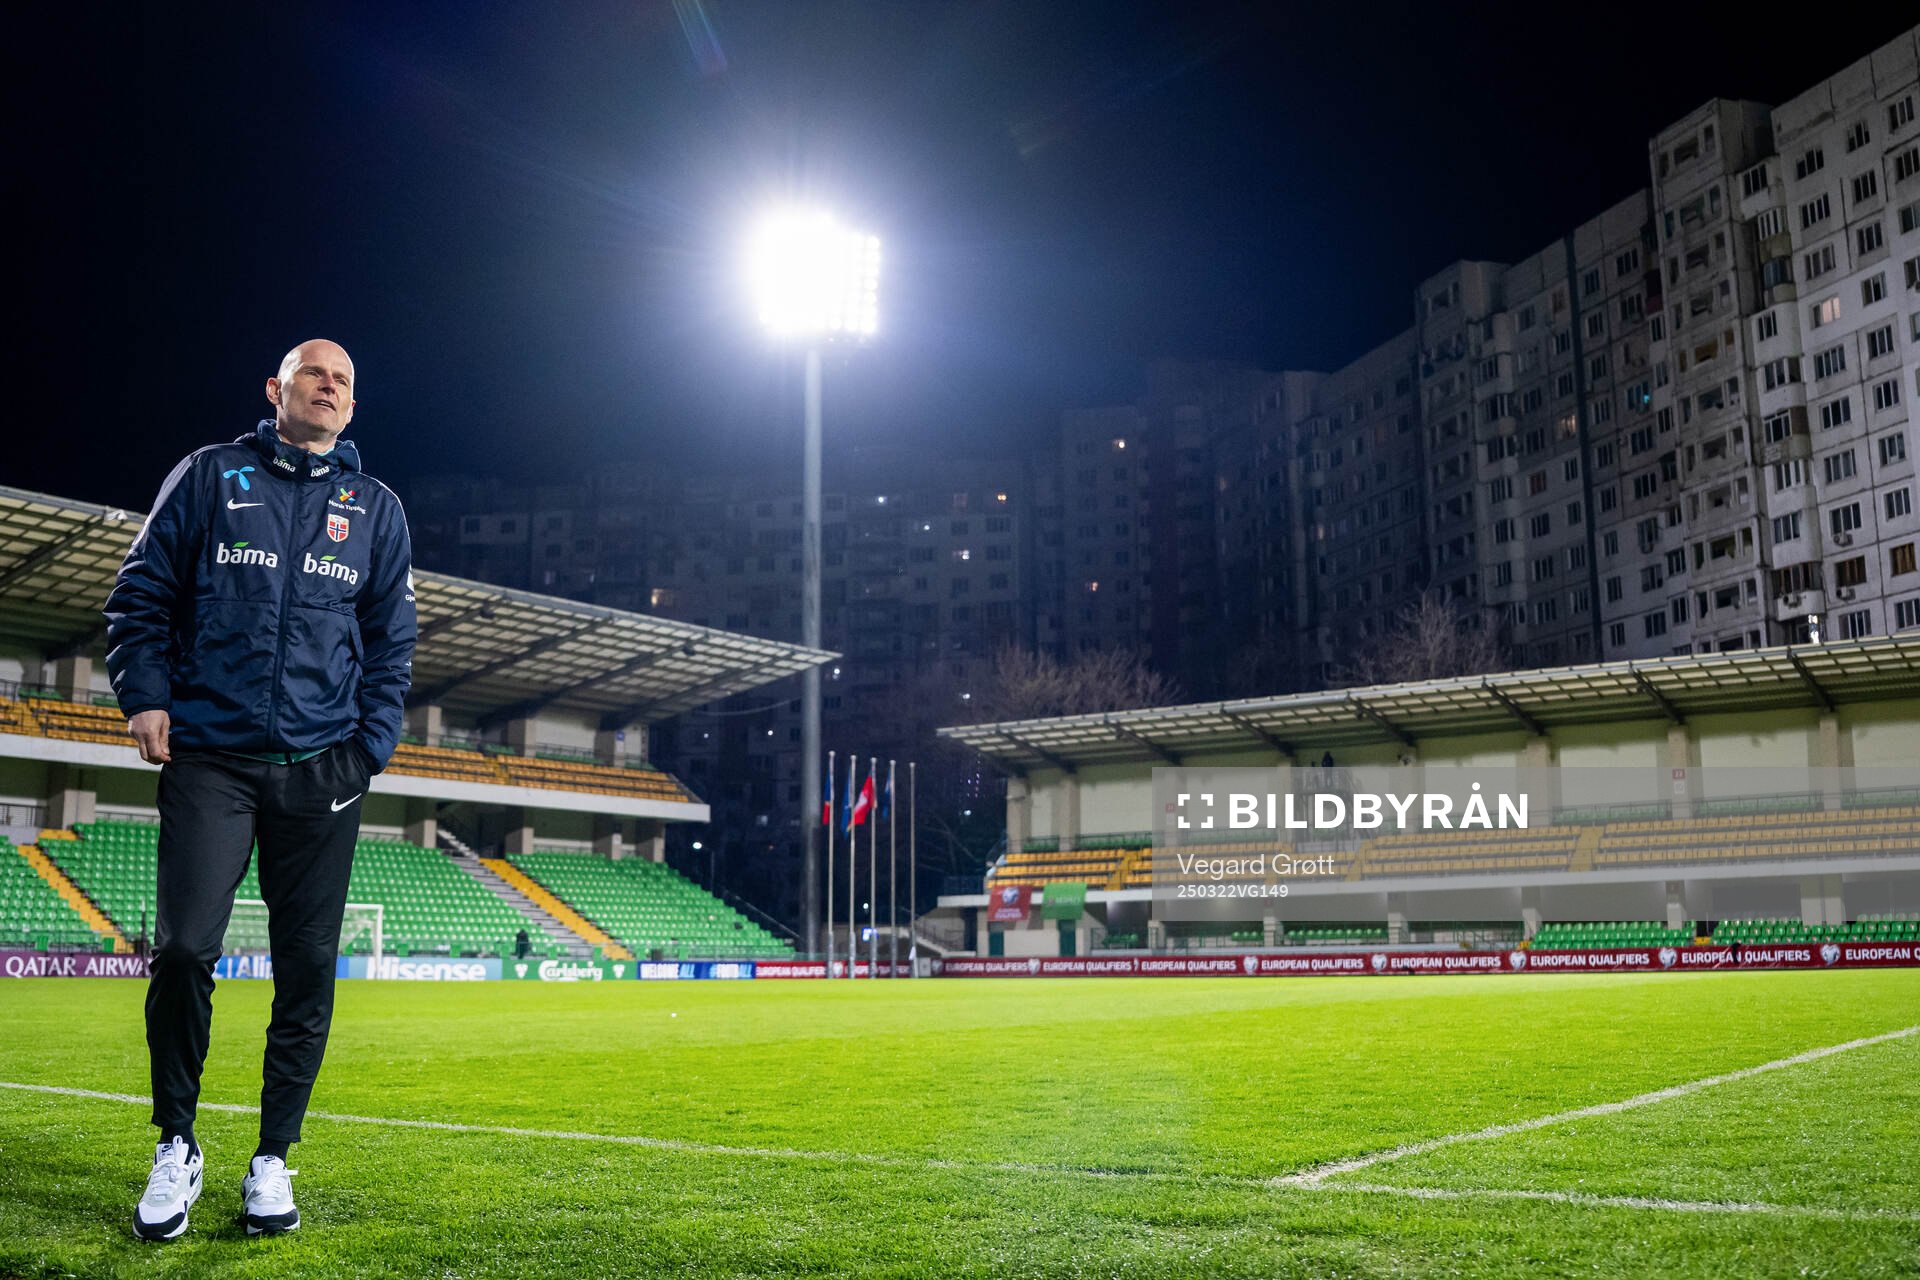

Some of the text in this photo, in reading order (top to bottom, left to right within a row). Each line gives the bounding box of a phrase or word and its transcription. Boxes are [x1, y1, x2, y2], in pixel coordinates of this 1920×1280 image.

[1530, 953, 1650, 968] EUROPEAN QUALIFIERS
[1745, 949, 1810, 964] QUALIFIERS
[1845, 947, 1911, 961] EUROPEAN
[5, 956, 77, 979] QATAR
[366, 957, 487, 981] Hisense
[1043, 960, 1132, 973] EUROPEAN QUALIFIERS
[1142, 959, 1236, 972] EUROPEAN QUALIFIERS
[1261, 957, 1364, 971] EUROPEAN QUALIFIERS
[1391, 955, 1500, 969] EUROPEAN QUALIFIERS
[538, 959, 603, 982] Carlsberg
